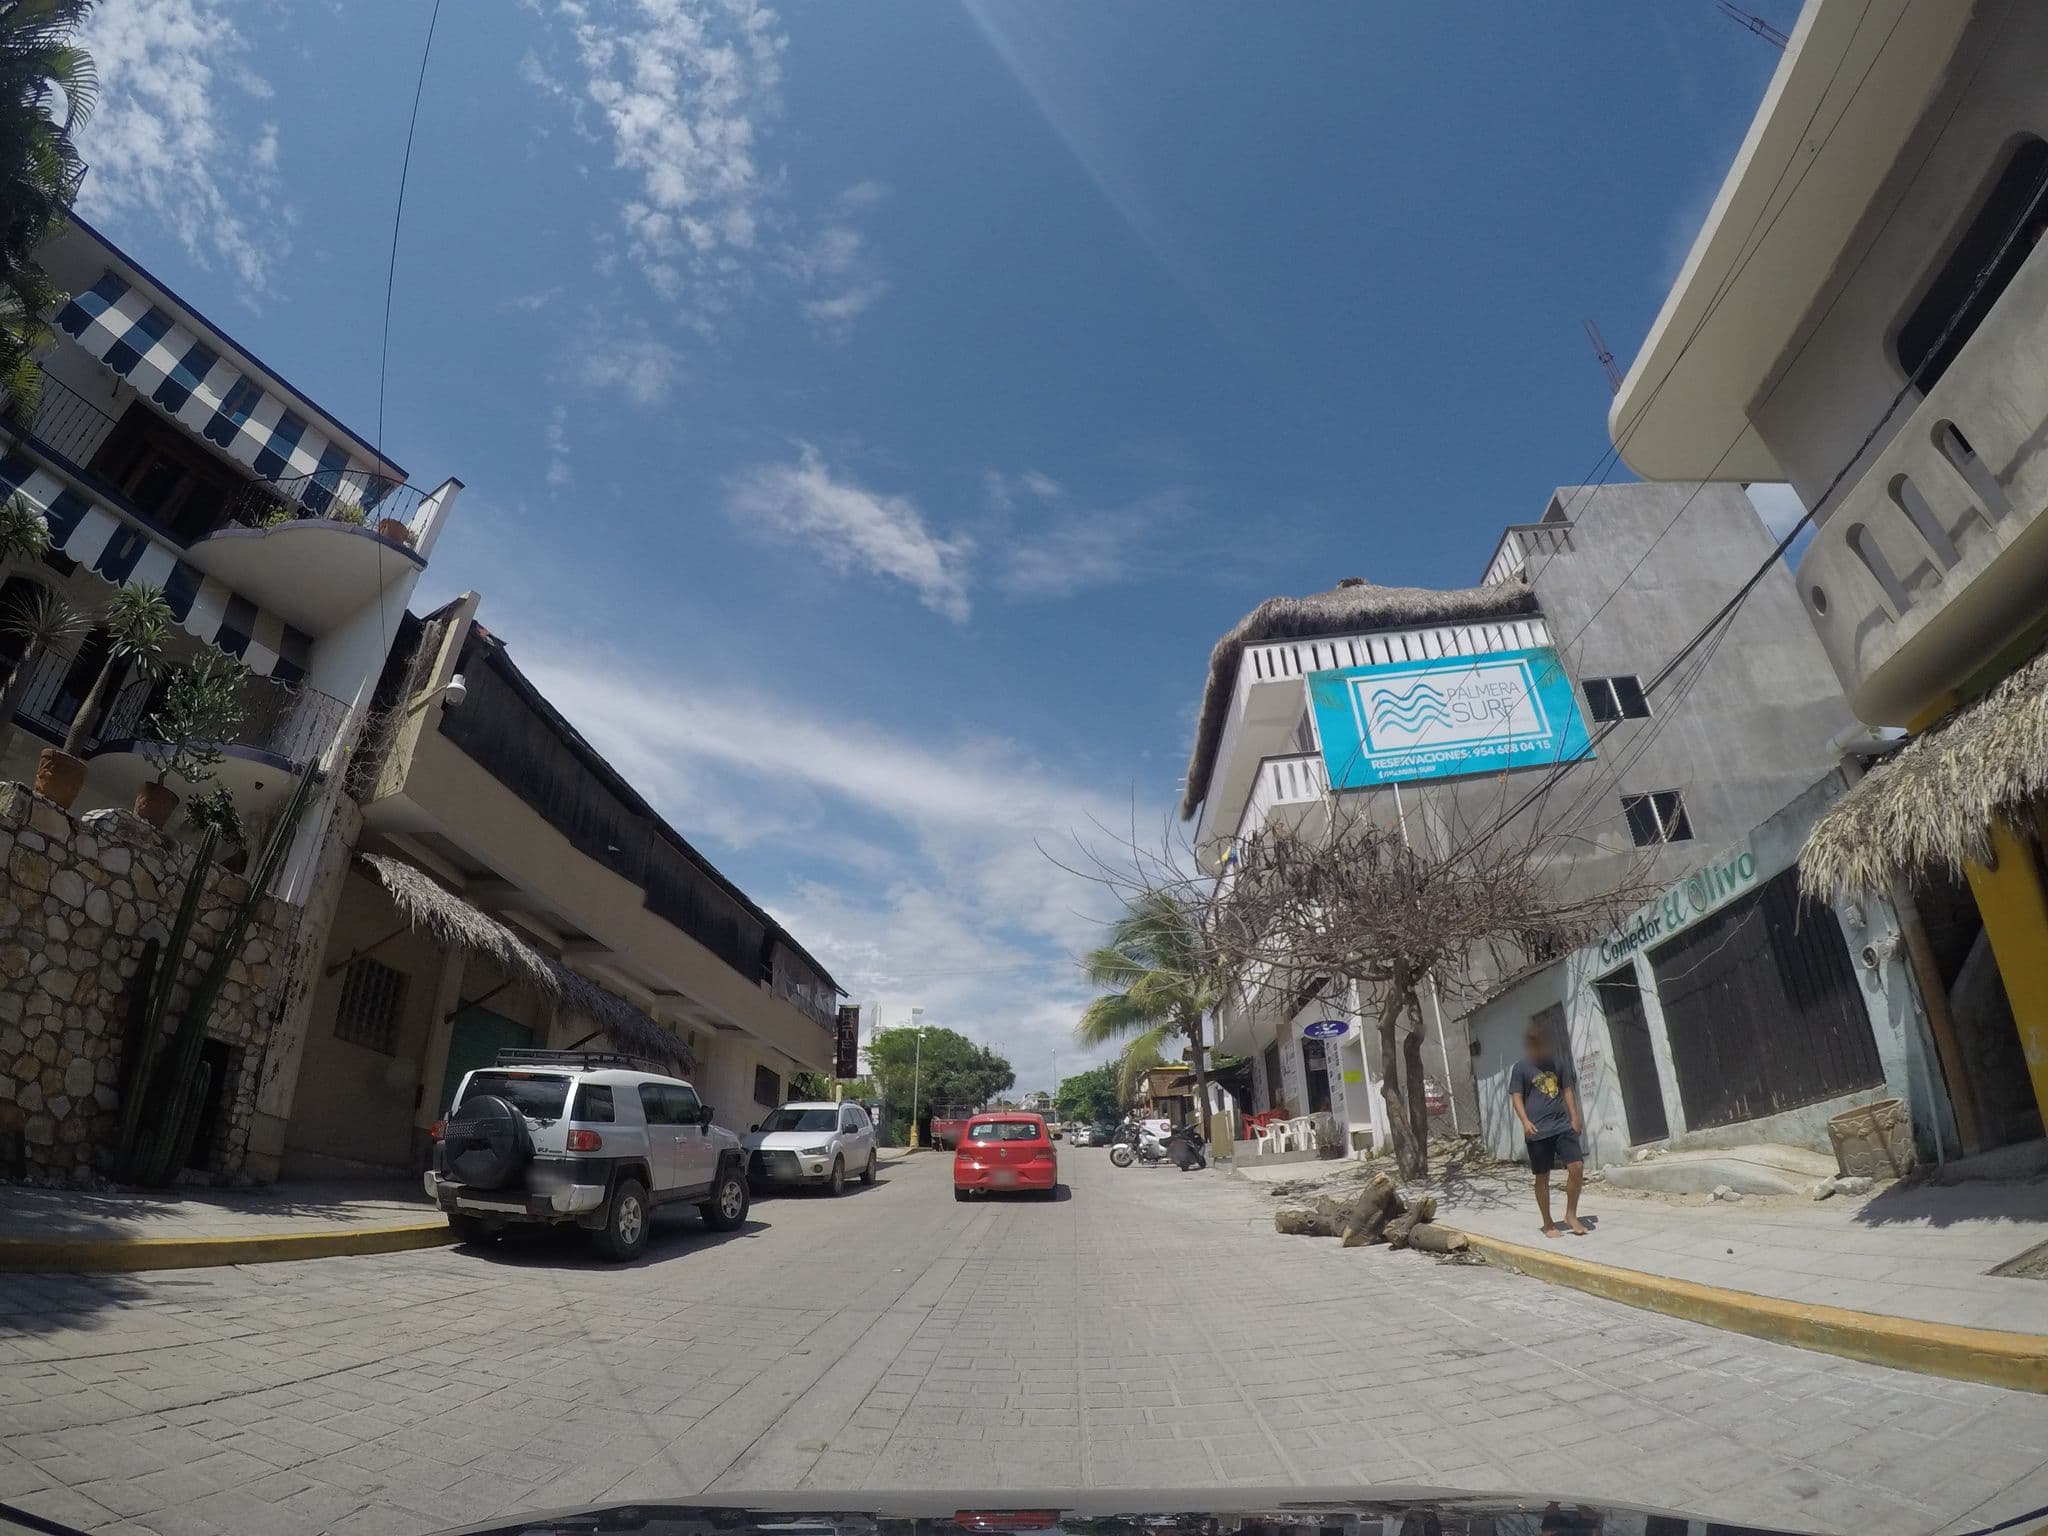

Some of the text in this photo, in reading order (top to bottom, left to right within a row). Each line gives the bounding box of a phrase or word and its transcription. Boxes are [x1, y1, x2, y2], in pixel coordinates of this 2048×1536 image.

[1446, 681, 1521, 700] PALMERA
[1452, 697, 1514, 722] SURF
[1371, 748, 1472, 770] RESERVACIONES:
[1473, 746, 1496, 758] 954
[1519, 741, 1535, 752] 04
[1536, 739, 1552, 750] 15
[1601, 852, 1756, 965] Comedor El Olivo
